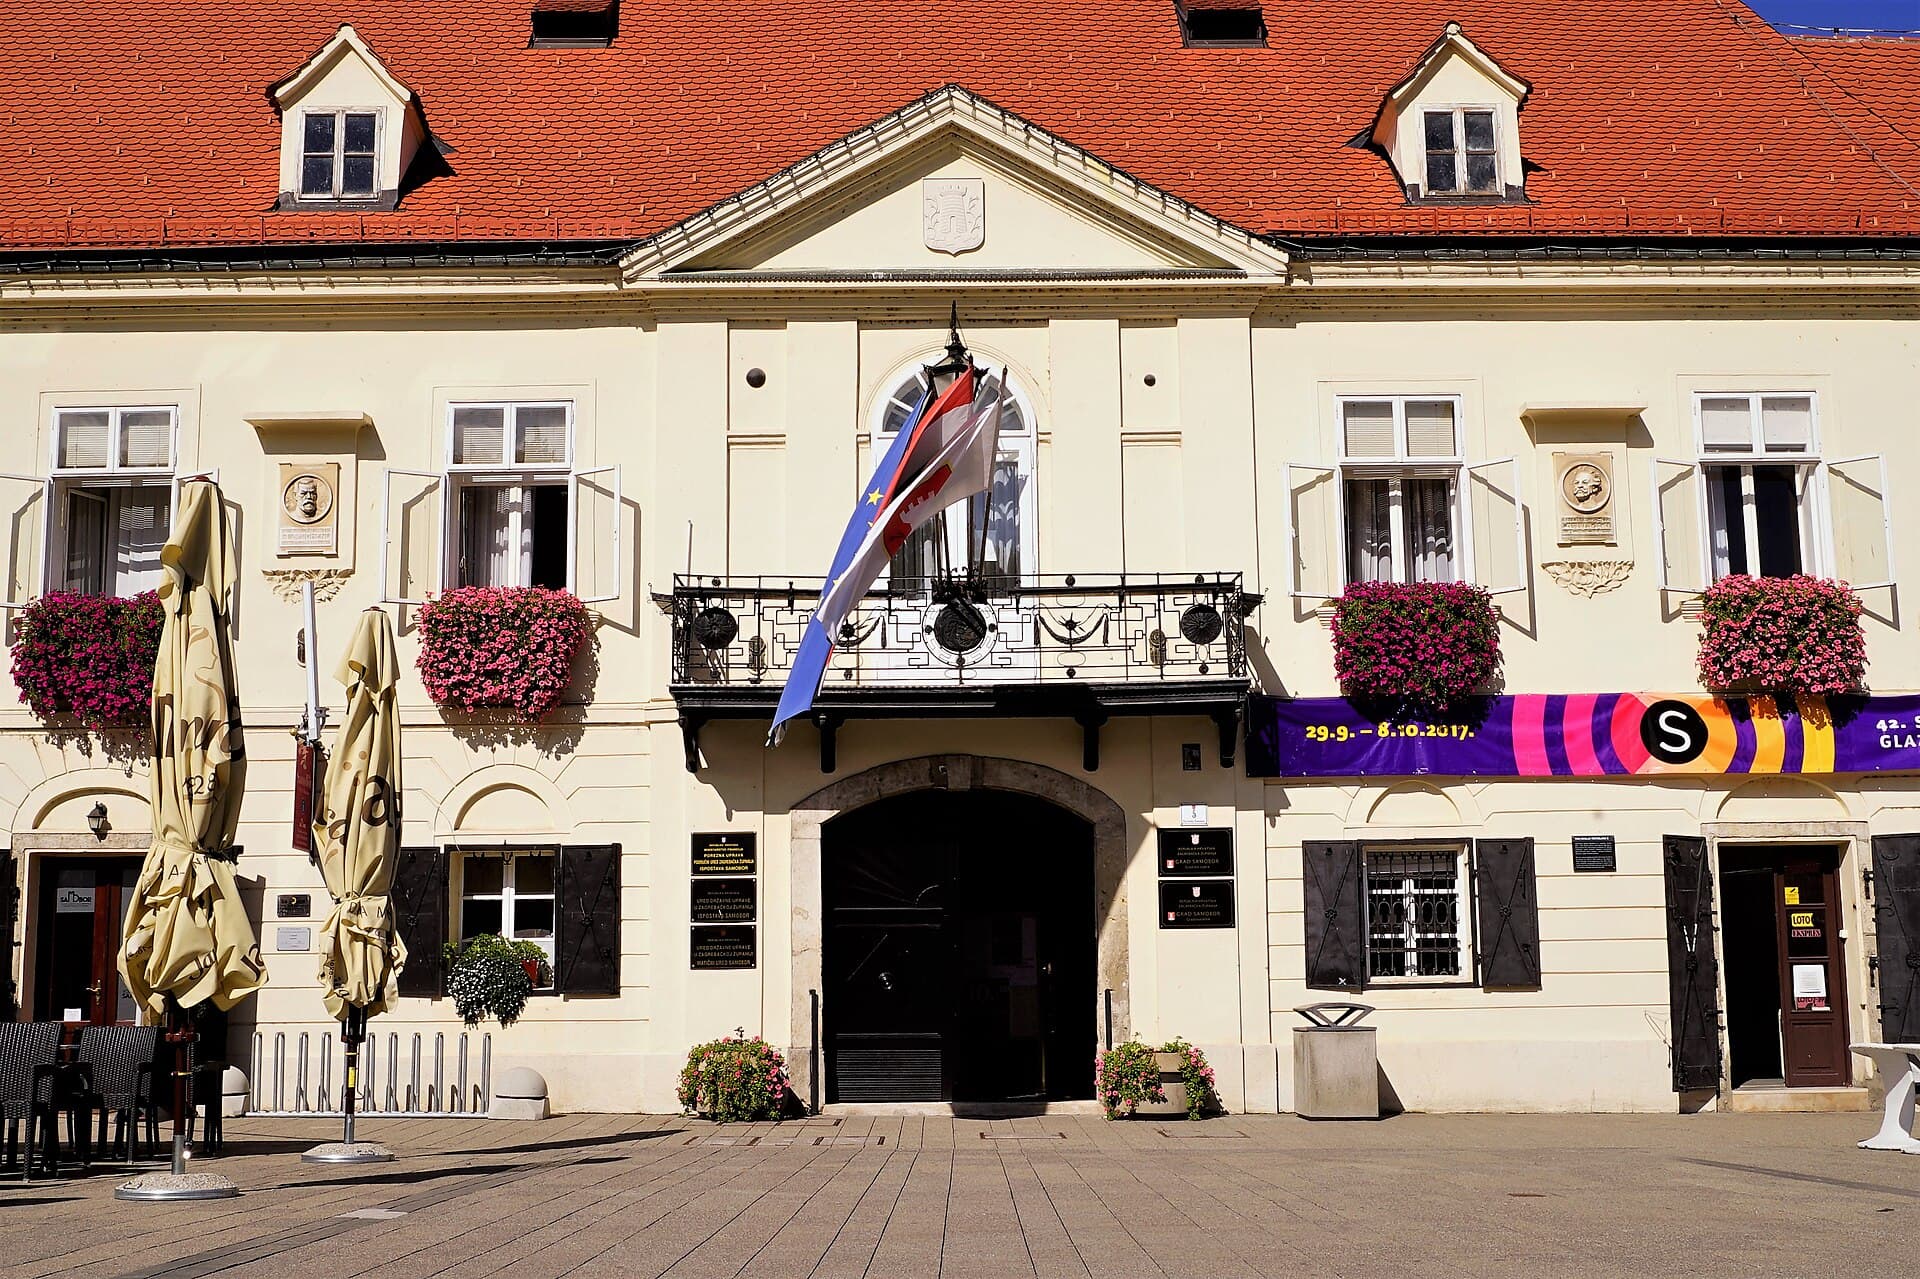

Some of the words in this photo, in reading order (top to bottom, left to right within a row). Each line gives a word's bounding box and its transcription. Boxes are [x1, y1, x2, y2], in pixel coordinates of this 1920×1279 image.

[1659, 710, 1691, 752] S
[1876, 719, 1907, 731] 42.
[1305, 725, 1355, 742] 29.9.
[1793, 914, 1811, 925] LOTO
